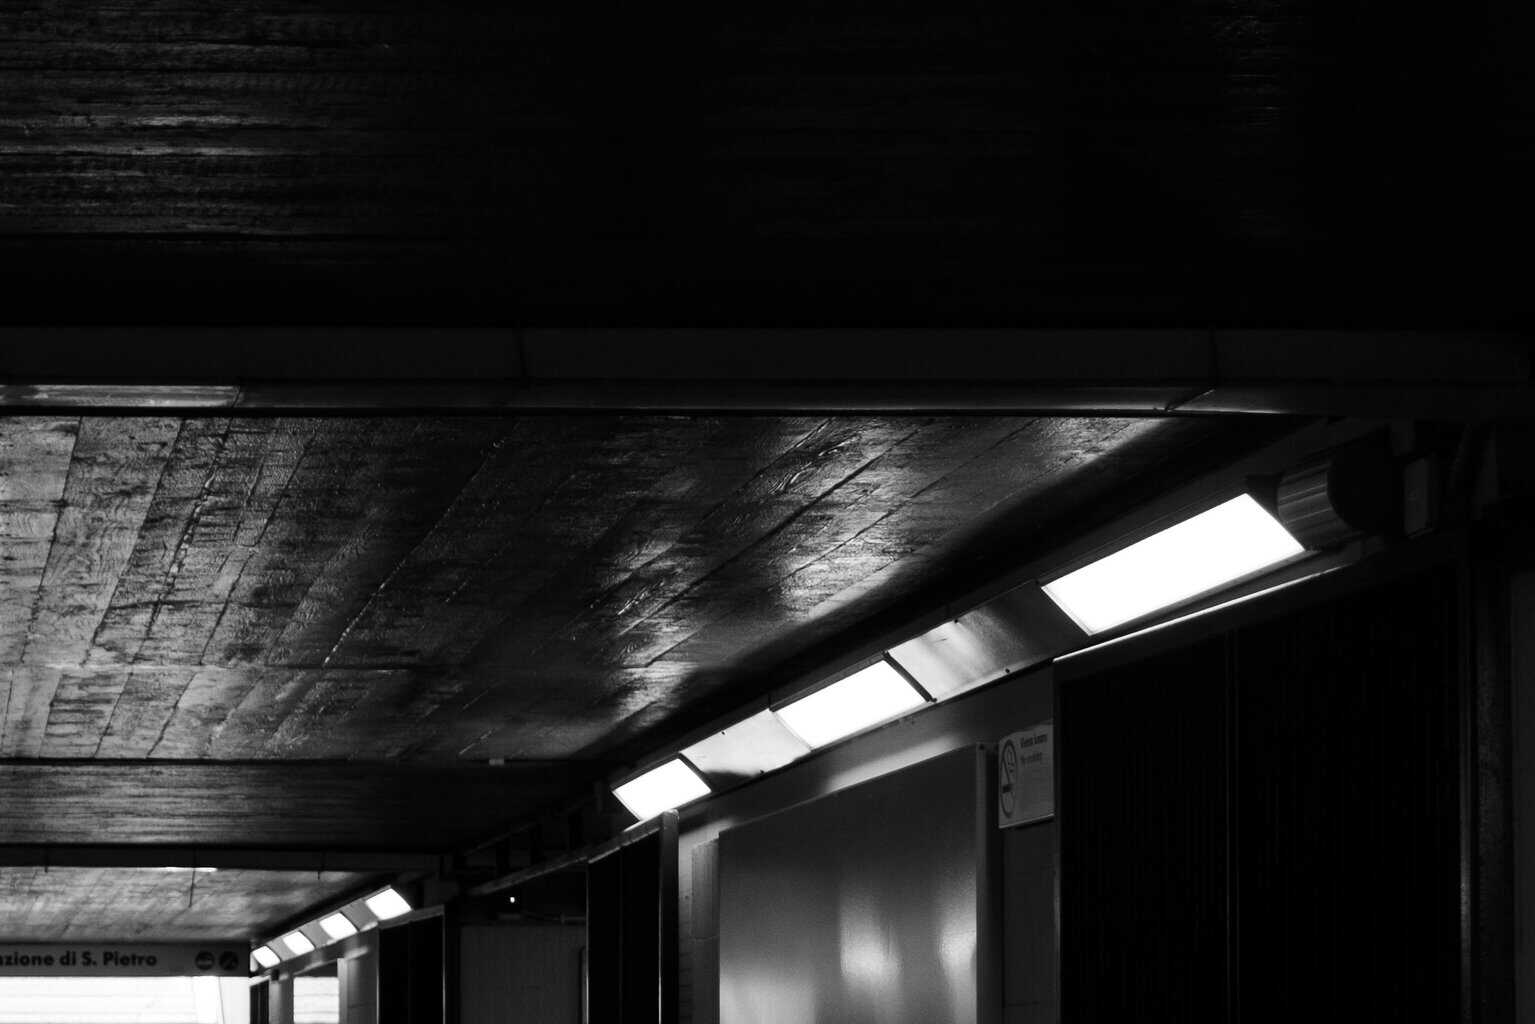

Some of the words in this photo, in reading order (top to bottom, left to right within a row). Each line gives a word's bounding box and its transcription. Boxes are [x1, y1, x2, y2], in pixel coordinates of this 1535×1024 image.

[59, 950, 77, 967] di
[81, 950, 97, 967] S.
[102, 950, 158, 967] Pietro
